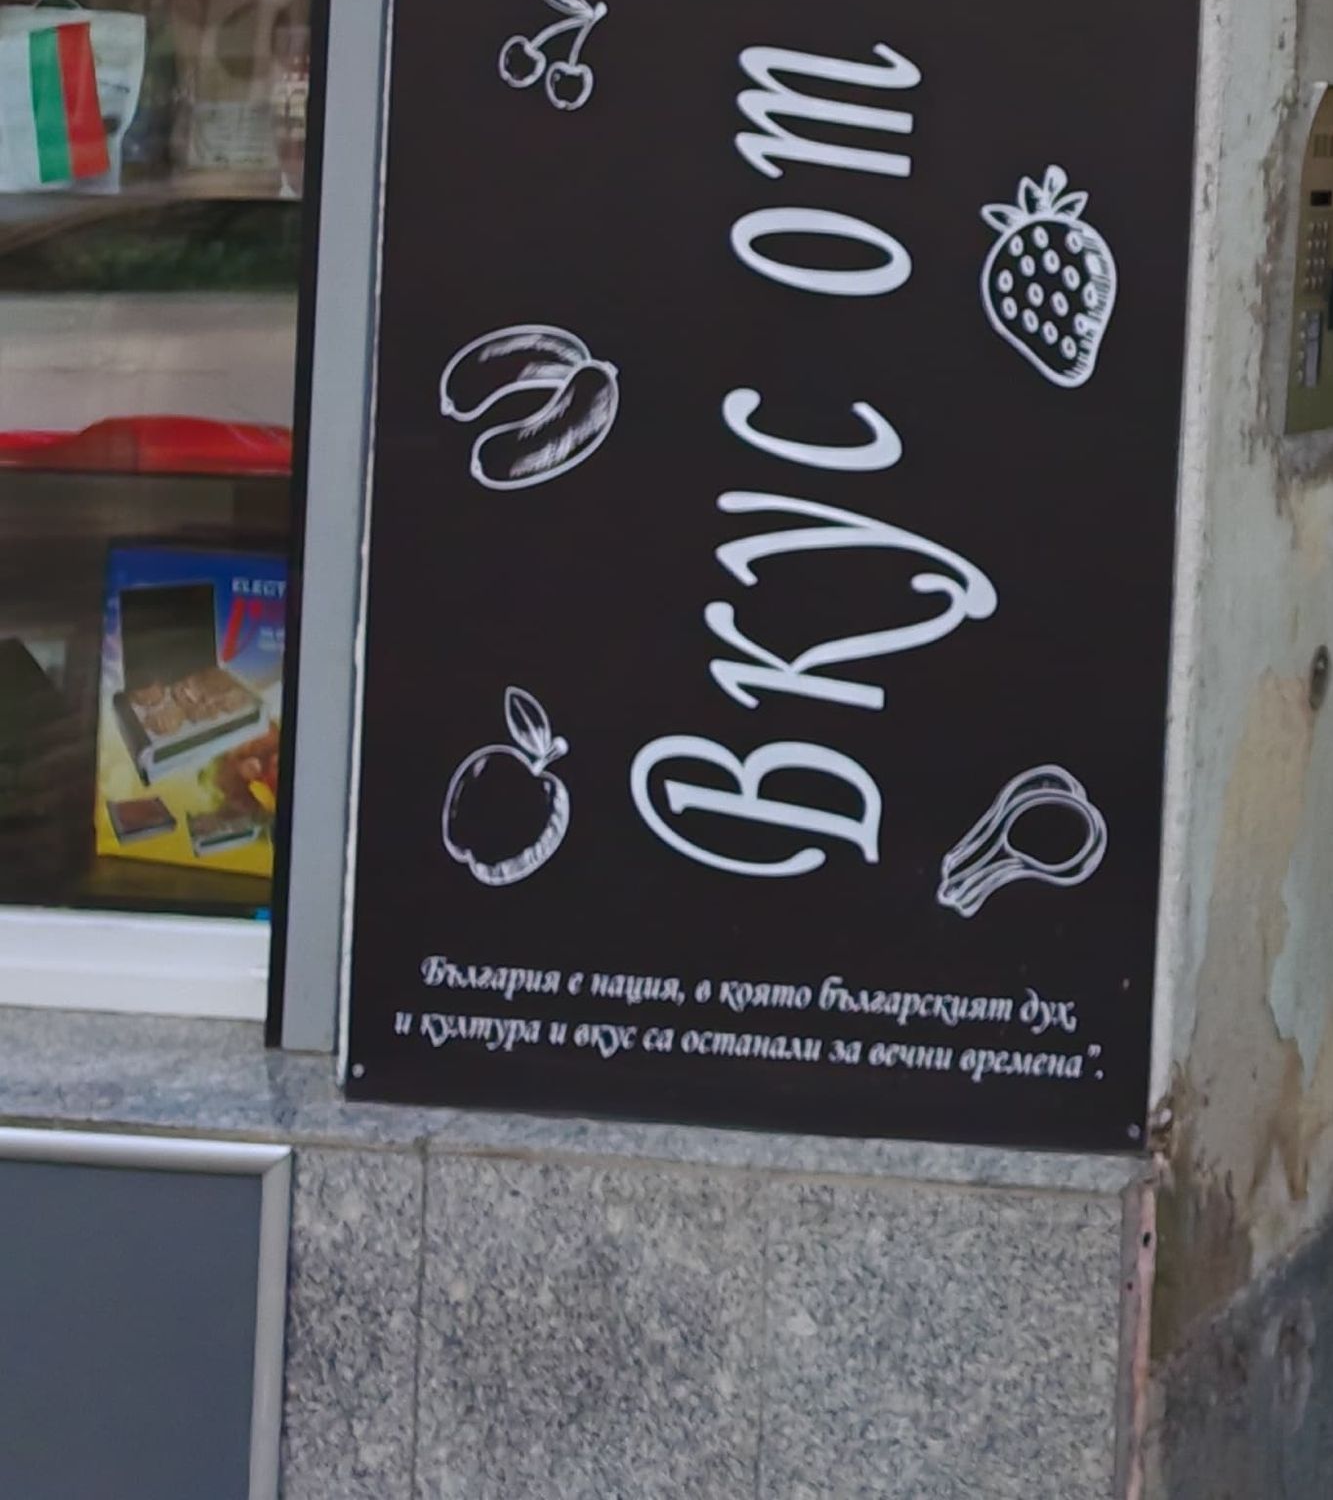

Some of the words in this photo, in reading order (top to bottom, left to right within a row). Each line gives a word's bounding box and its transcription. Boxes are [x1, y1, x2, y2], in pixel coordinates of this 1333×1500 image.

[730, 43, 921, 296] от
[630, 387, 998, 876] Вкус
[395, 1011, 413, 1035] и
[419, 1012, 543, 1051] култура
[549, 1020, 569, 1045] и
[573, 1023, 637, 1059] вкус
[642, 1027, 675, 1052] са
[681, 1029, 822, 1062] останали
[828, 1039, 863, 1065] за
[867, 1041, 953, 1071] вечни
[420, 955, 562, 1000] България
[567, 972, 585, 995] е
[591, 972, 686, 1006] нация,
[694, 980, 713, 1002] в
[719, 980, 813, 1013] която
